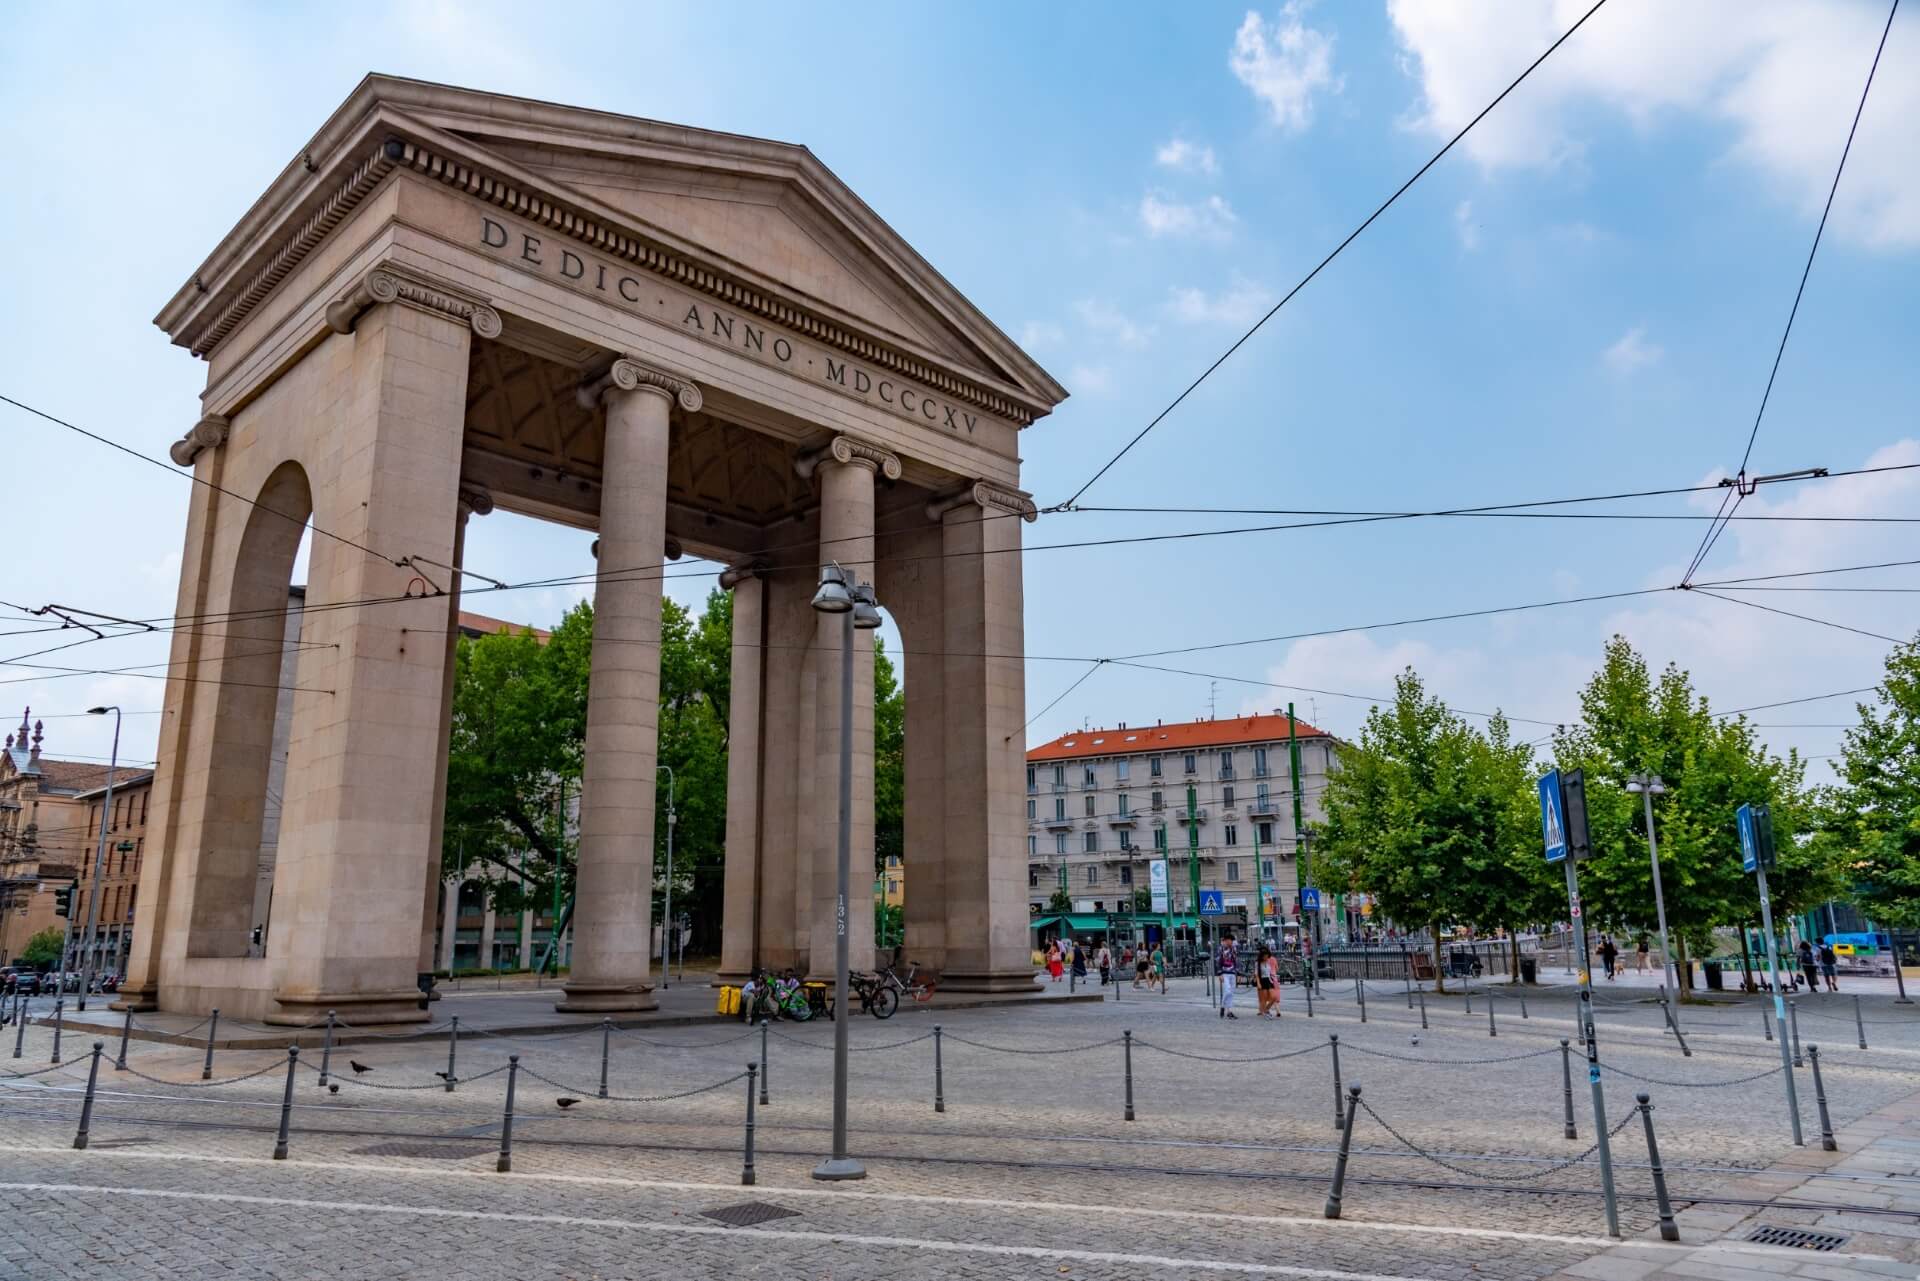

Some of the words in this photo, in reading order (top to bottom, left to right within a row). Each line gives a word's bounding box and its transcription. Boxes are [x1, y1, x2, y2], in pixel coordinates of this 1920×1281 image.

[481, 217, 640, 302] DEDIC
[683, 304, 792, 362] ANNO
[825, 358, 977, 434] MDCCCXV
